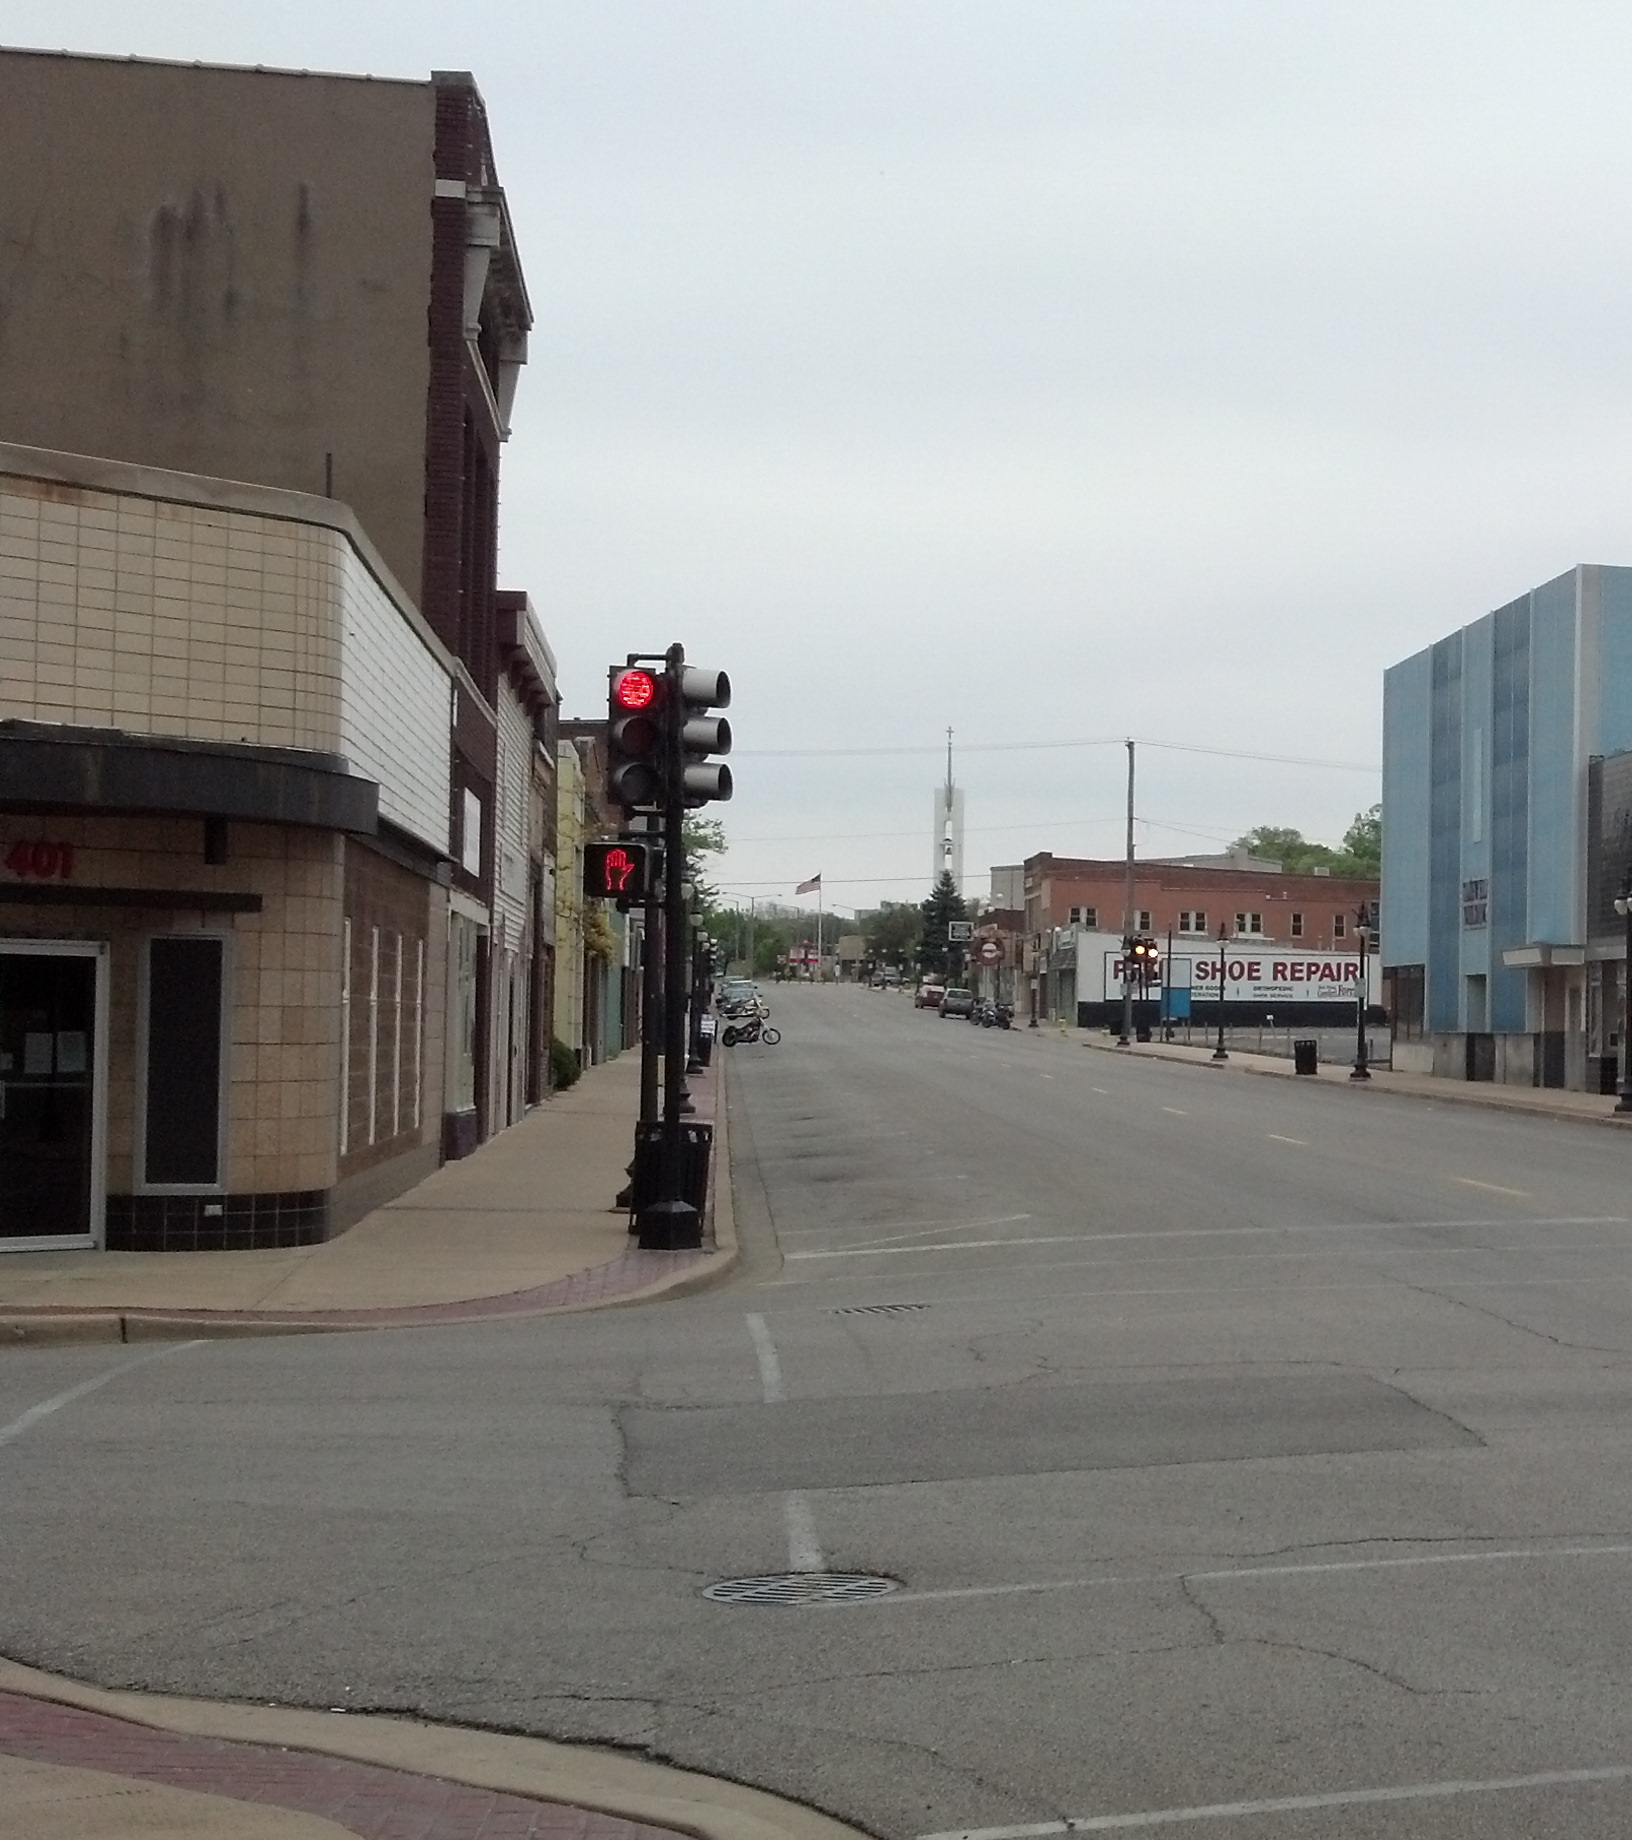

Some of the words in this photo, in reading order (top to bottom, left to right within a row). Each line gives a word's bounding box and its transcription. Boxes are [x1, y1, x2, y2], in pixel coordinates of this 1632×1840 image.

[7, 841, 75, 878] 401
[1195, 960, 1262, 981] SHOE
[1272, 961, 1361, 982] REPAIR
